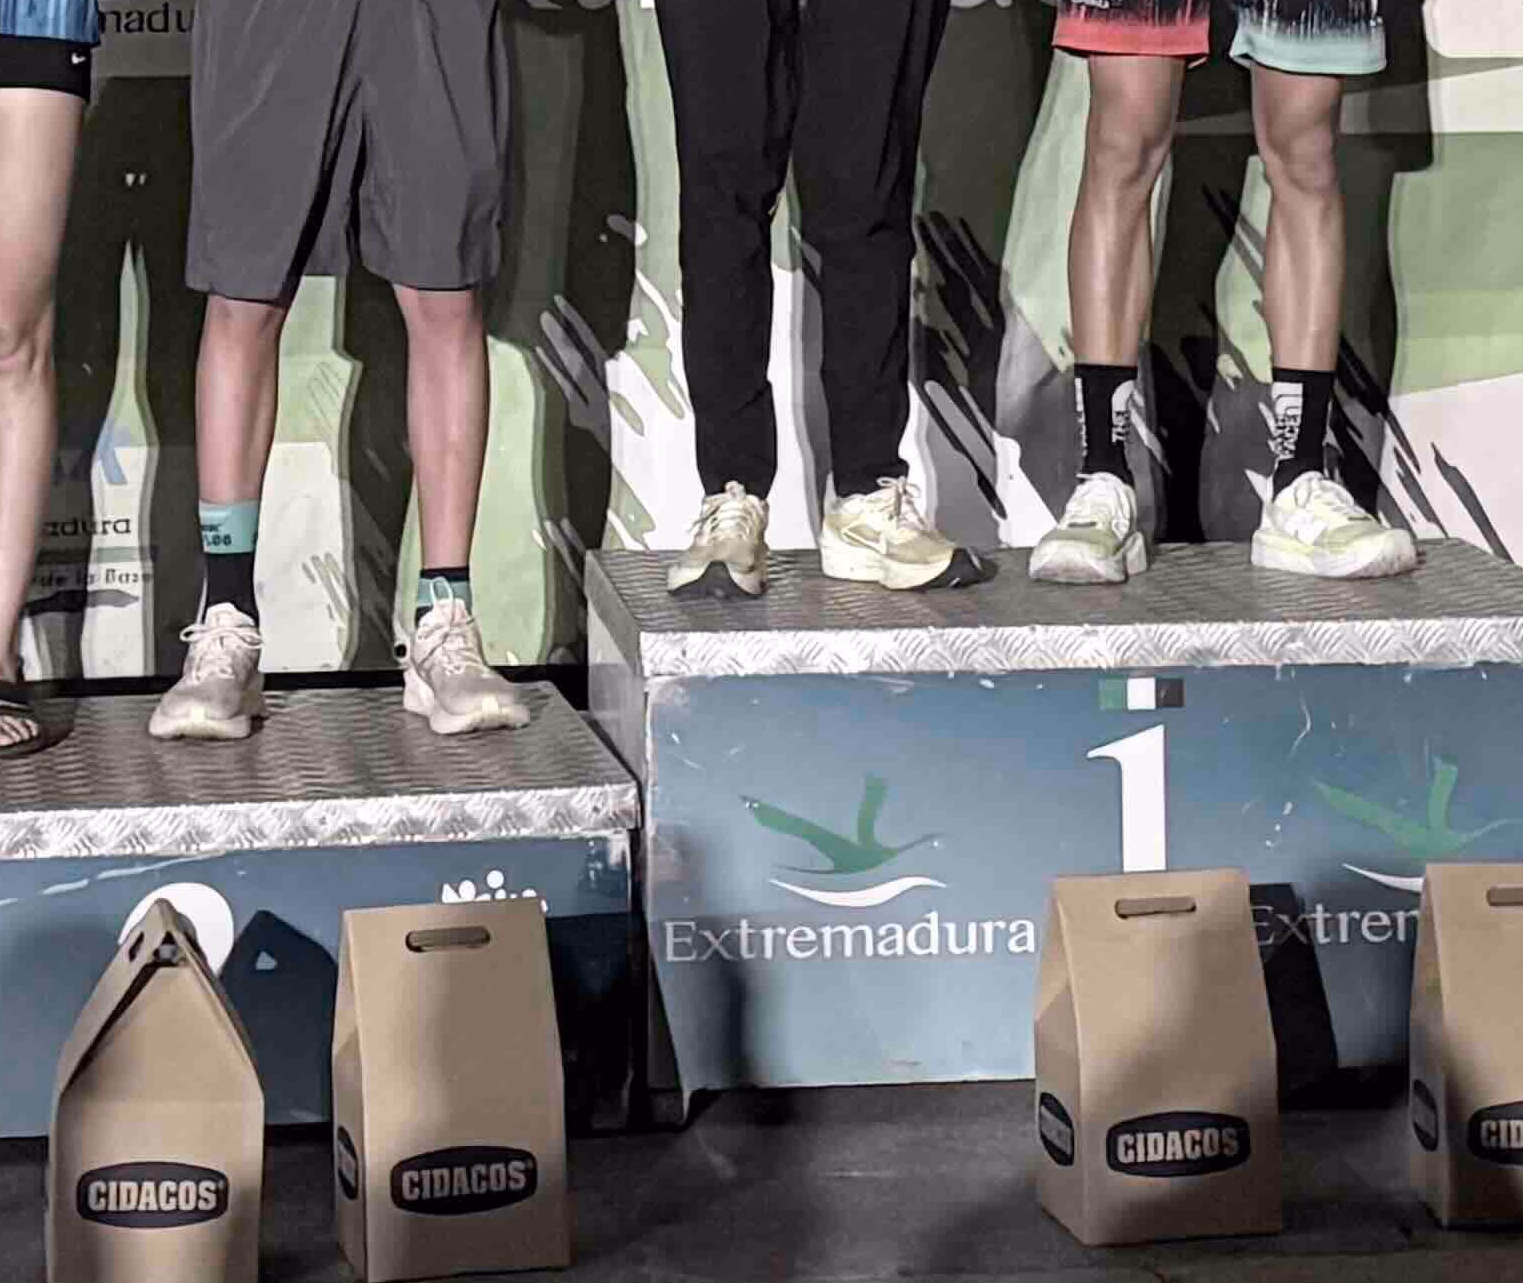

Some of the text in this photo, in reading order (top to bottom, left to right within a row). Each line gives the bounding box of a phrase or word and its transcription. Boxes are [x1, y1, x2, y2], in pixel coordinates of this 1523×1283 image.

[1085, 724, 1166, 872] 1
[664, 911, 1035, 963] Extremadura
[1116, 1127, 1241, 1164] CIDACOS
[88, 1180, 219, 1213] CIDACOS
[402, 1161, 529, 1201] CIDACOS
